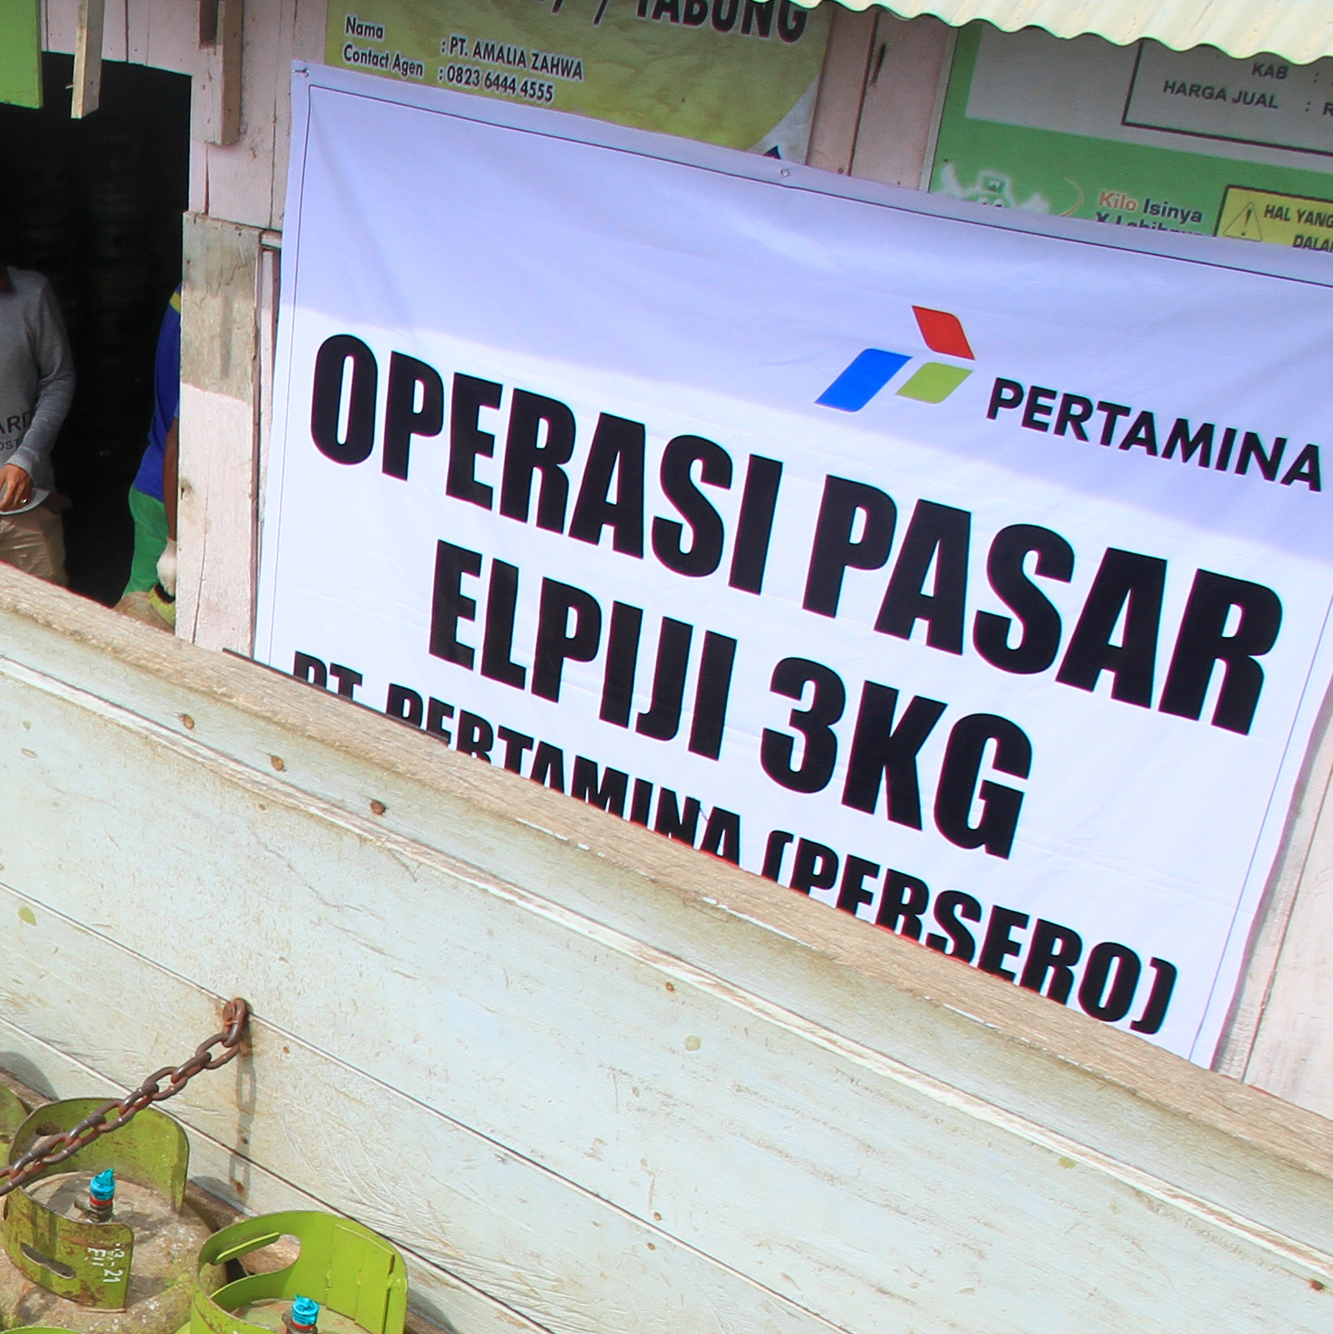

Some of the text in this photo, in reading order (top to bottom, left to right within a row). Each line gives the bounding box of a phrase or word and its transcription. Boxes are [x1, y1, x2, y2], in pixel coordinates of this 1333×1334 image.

[343, 43, 390, 69] Contact
[392, 53, 424, 79] Agen
[446, 65, 480, 88] 0823
[484, 71, 517, 96] 6444
[520, 77, 555, 102] 4555
[345, 15, 384, 40] Nama
[449, 36, 470, 57] PT.
[472, 39, 527, 69] AMALIA
[531, 50, 584, 81] ZAHWA
[1251, 61, 1289, 81] KAB
[1163, 80, 1227, 103] HARGA
[1231, 88, 1279, 110] JUAL
[1098, 191, 1138, 212] Kilo
[1143, 198, 1203, 225] Isinya
[1264, 204, 1291, 222] HAL
[987, 376, 1323, 492] PERTAMINA
[309, 333, 1284, 736] OPERASI PASAR
[428, 539, 1033, 860] ELPIJI 3KG
